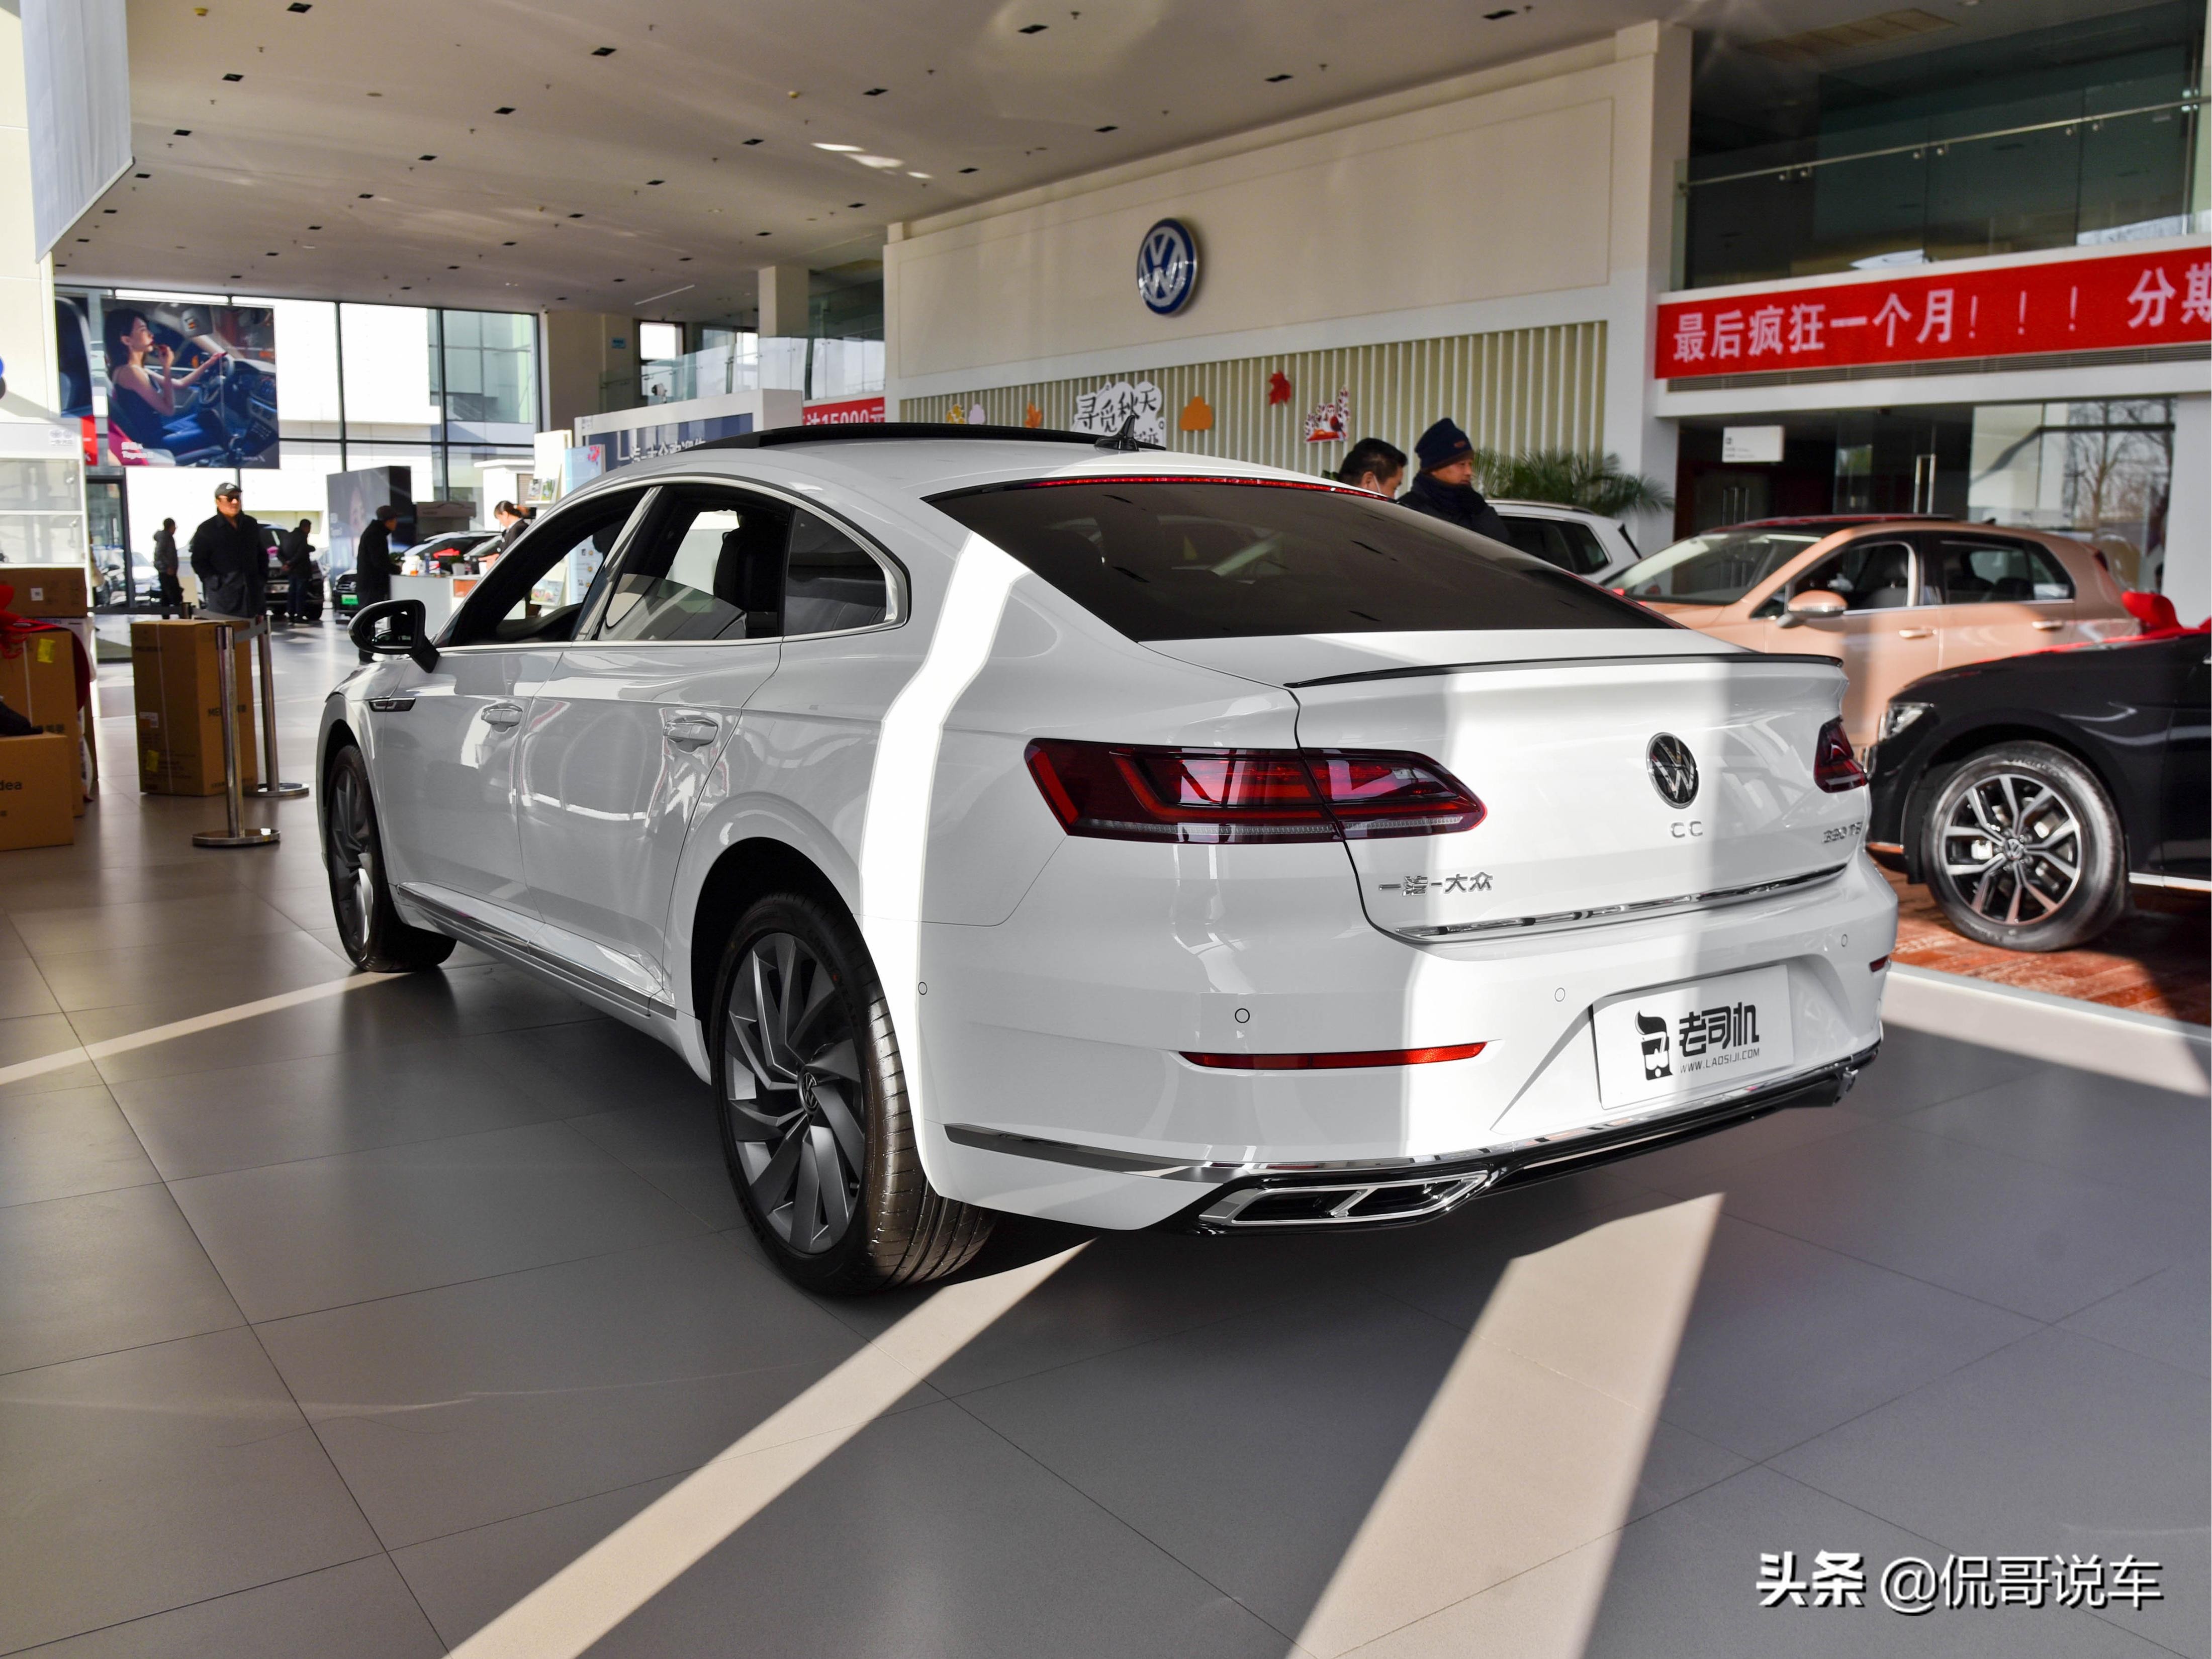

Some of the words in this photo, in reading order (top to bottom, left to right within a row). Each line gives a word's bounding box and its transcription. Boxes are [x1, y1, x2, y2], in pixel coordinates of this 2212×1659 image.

[1077, 388, 1157, 433] 寻觅秋天
[1669, 820, 1703, 838] CC
[1679, 1002, 1760, 1057] 老司机
[1680, 1047, 1760, 1074] WWW.LAOSIJI.COM
